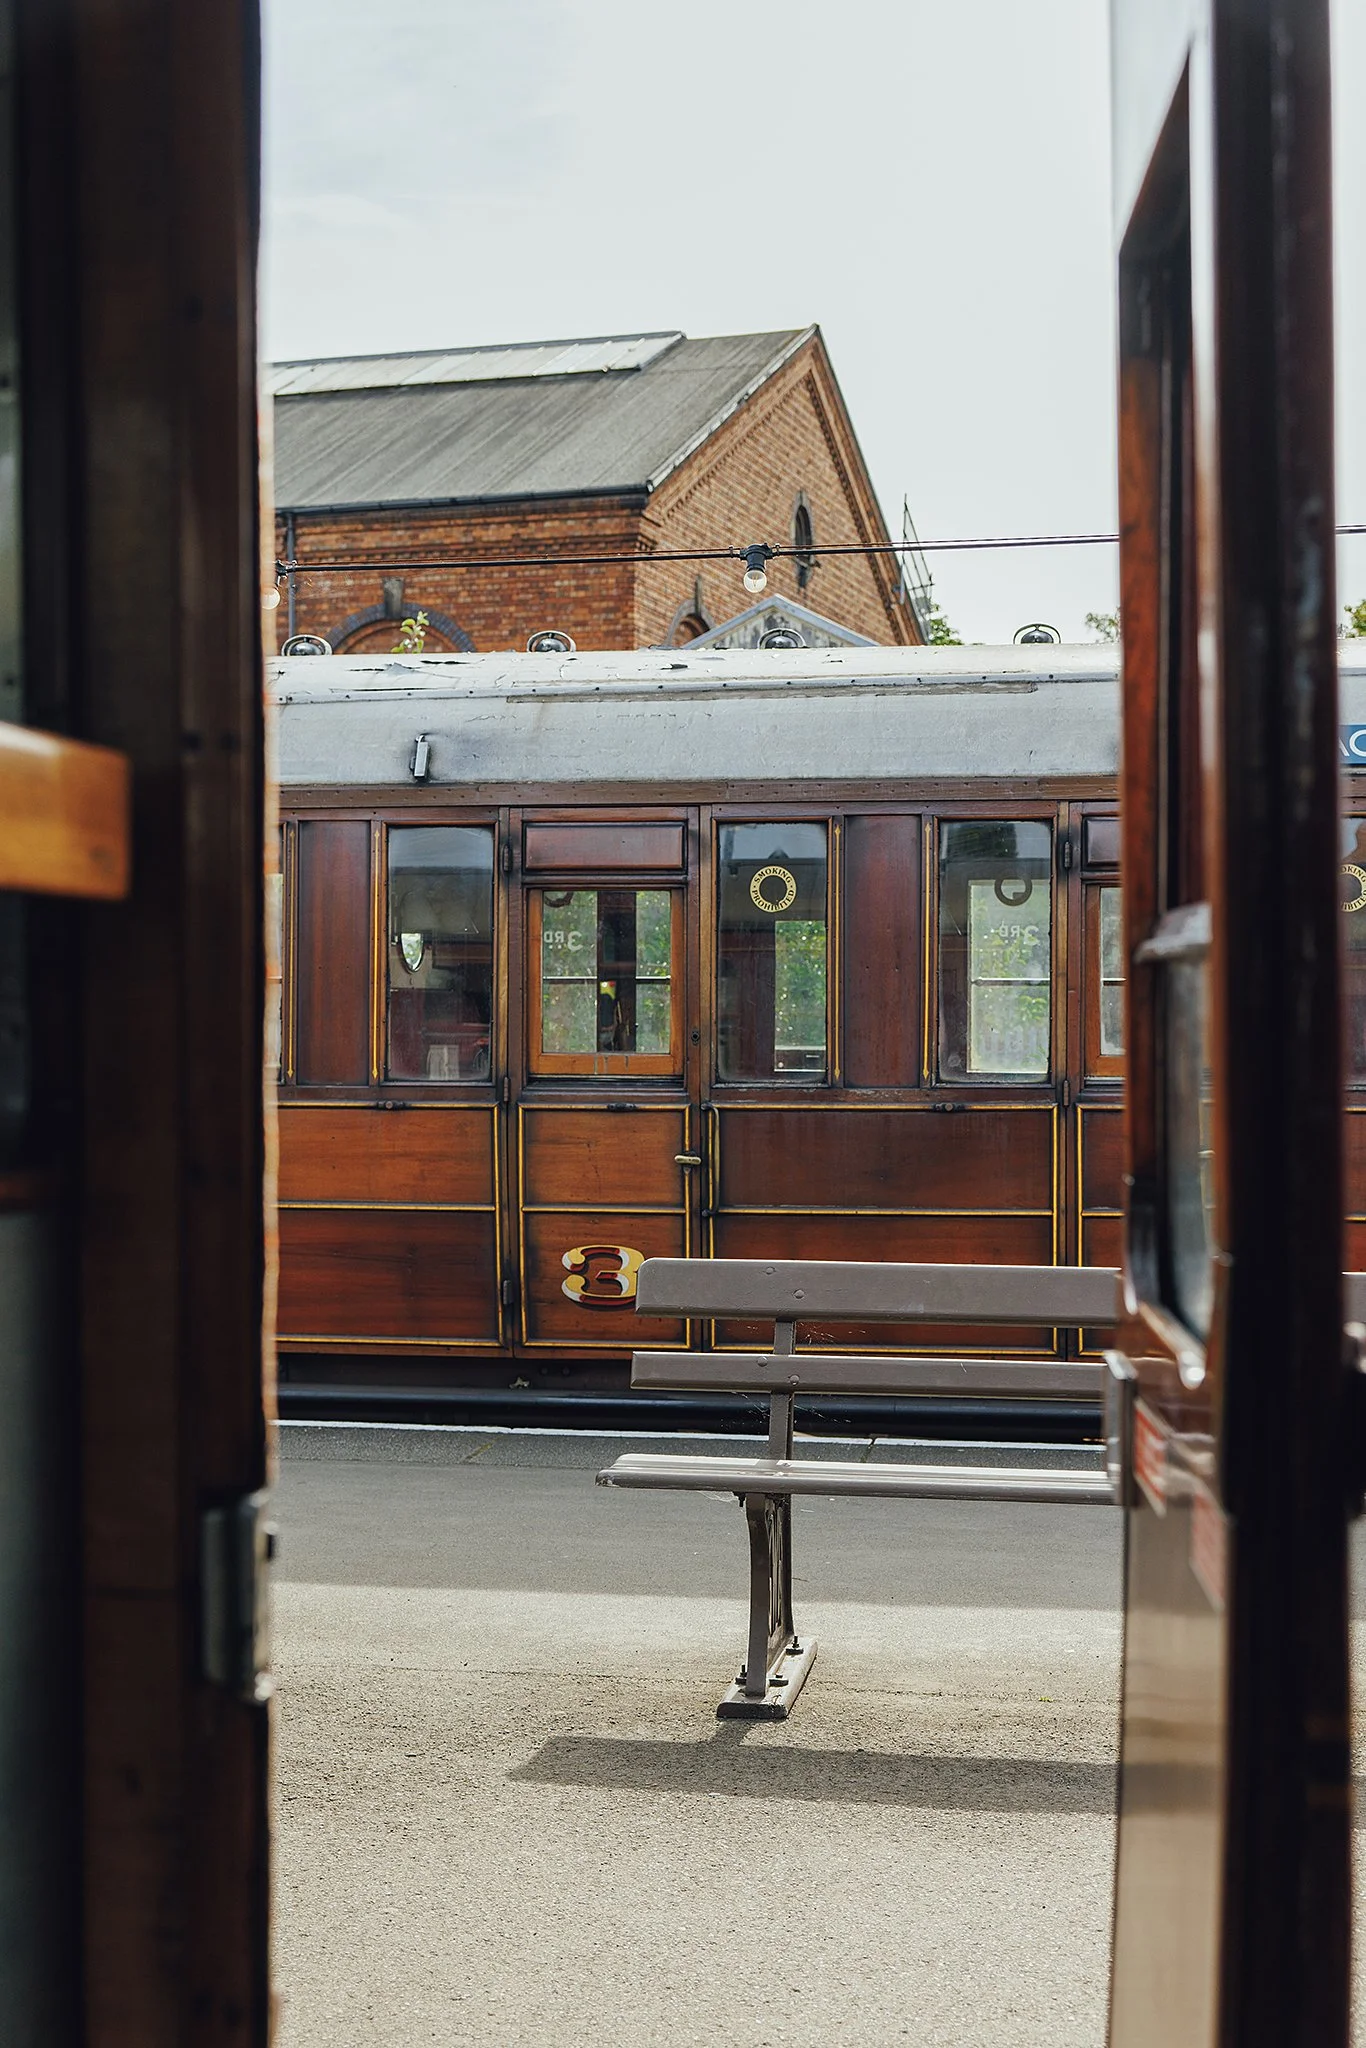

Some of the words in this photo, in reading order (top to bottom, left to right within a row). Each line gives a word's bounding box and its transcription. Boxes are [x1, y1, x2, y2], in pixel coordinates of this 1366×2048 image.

[753, 867, 793, 883] SMOKING
[1341, 865, 1366, 883] OKING
[751, 889, 795, 911] PROHIBITED
[561, 1244, 646, 1311] 3
